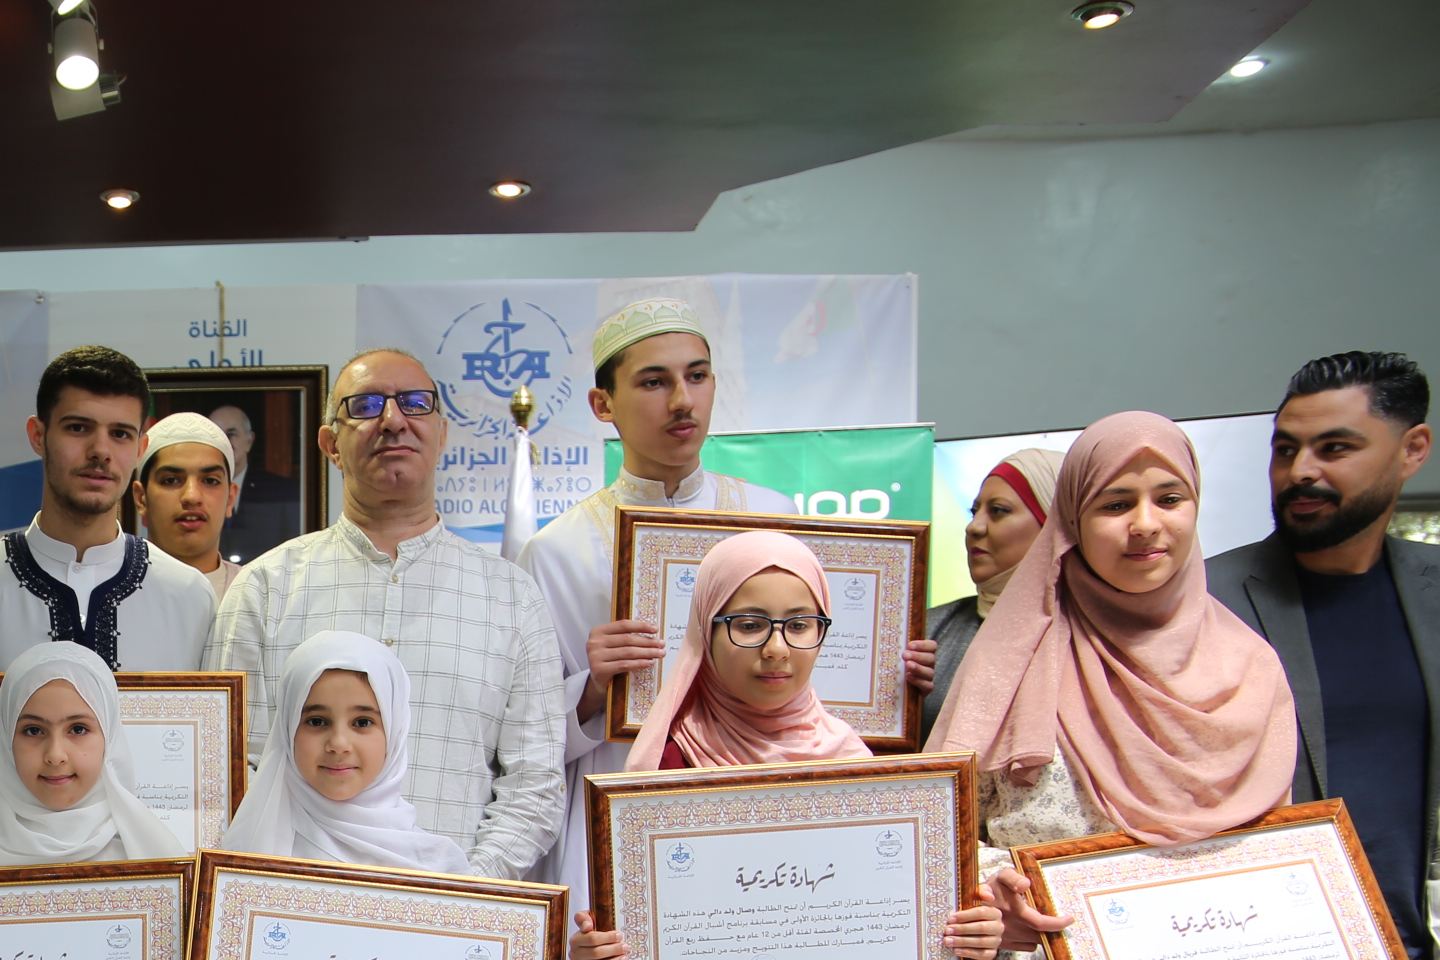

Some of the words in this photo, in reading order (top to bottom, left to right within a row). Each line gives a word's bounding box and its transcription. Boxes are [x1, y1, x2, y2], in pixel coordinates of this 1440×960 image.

[188, 318, 247, 338] القناة
[436, 446, 506, 471] الجزائر
[534, 446, 589, 472] الإذا
[435, 499, 474, 514] ADIO
[735, 862, 787, 892] تكريمية
[790, 863, 835, 893] شهادة
[1171, 908, 1216, 937] تكريمية
[1217, 905, 1258, 932] شهادة
